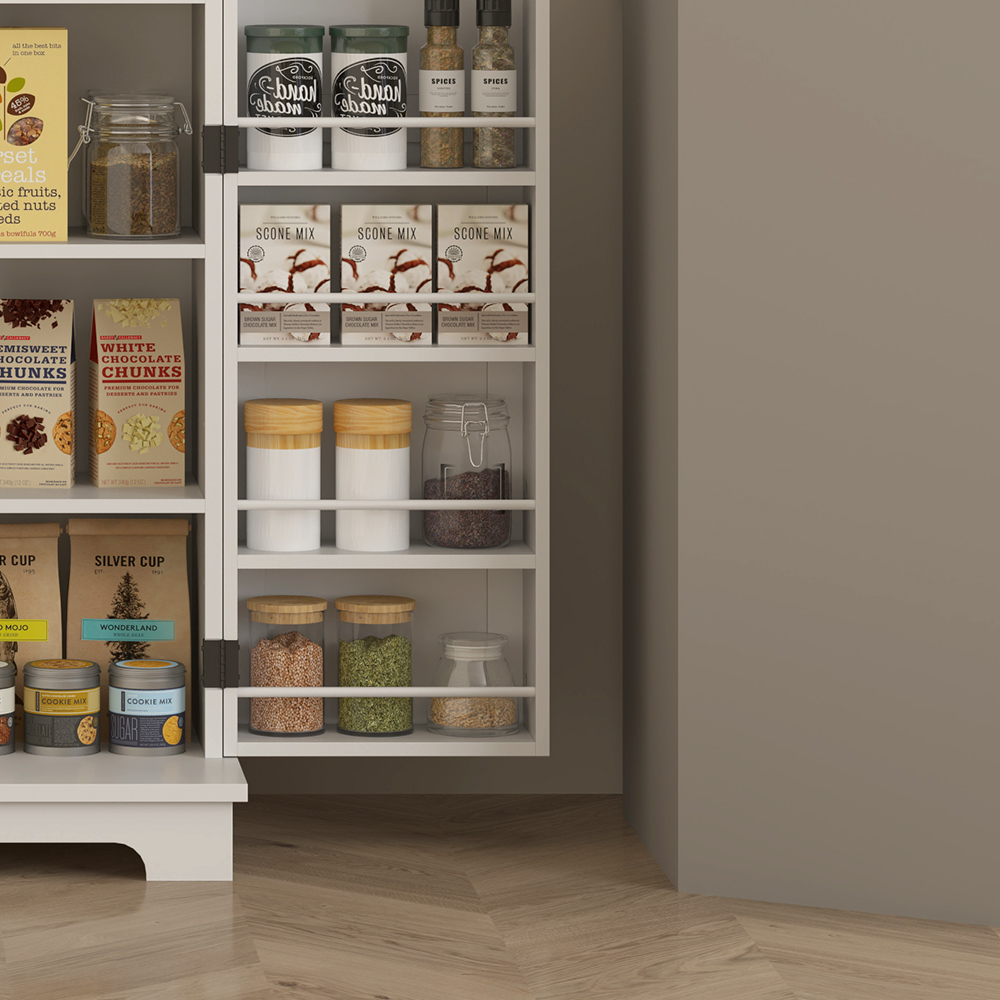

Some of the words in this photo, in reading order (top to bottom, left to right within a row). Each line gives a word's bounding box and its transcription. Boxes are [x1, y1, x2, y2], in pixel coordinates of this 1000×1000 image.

[18, 186, 61, 199] fruits,
[23, 201, 56, 211] nuts
[38, 230, 56, 238] 700g
[256, 227, 291, 240] SCONE
[295, 227, 315, 240] MIX
[357, 227, 393, 240] SCONE
[397, 227, 417, 240] MIX
[454, 227, 489, 240] SCONE
[493, 227, 513, 240] MIX
[100, 343, 156, 352] WHITE
[101, 355, 181, 363] CHOCOLATE
[101, 366, 181, 378] CHUNKS
[11, 555, 36, 566] CUP
[94, 555, 136, 567] SILVER
[140, 556, 165, 567] CUP
[111, 714, 138, 740] SUGAR
